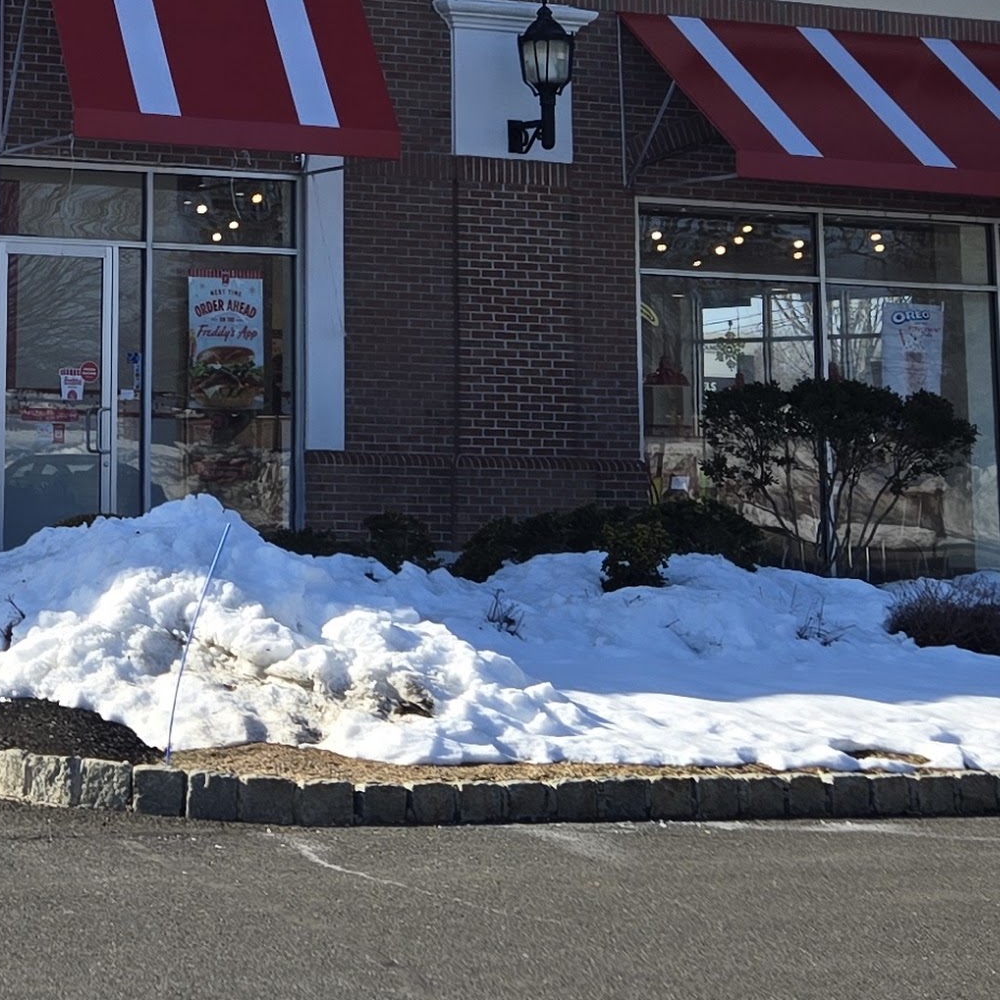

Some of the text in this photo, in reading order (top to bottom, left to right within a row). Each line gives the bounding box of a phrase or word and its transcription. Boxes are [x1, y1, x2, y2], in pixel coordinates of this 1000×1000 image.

[194, 299, 257, 319] ORDER AHEAD
[891, 310, 930, 325] OREO
[197, 324, 259, 342] Freddy's App
